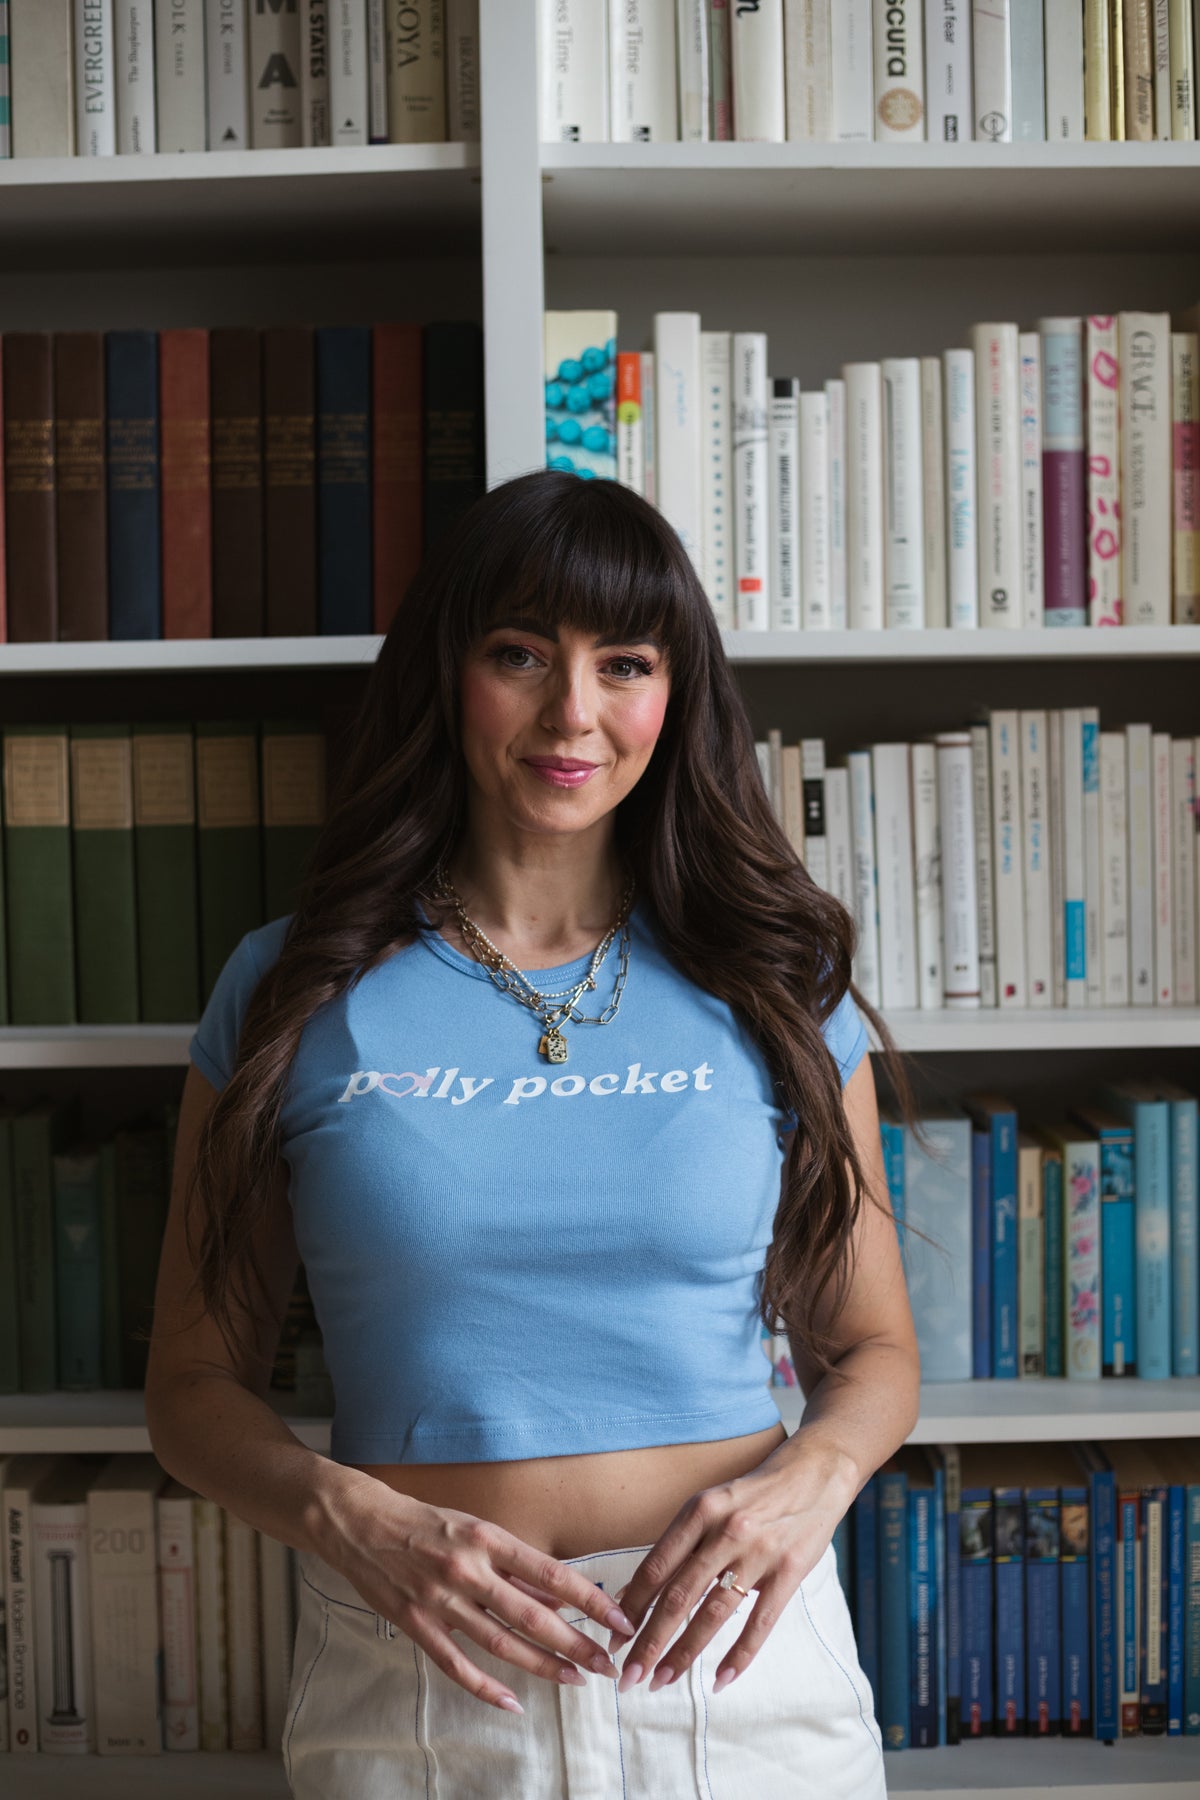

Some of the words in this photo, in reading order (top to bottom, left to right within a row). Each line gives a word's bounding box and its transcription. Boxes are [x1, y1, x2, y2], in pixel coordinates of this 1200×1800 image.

[310, 14, 325, 79] STATES
[555, 27, 574, 74] Time
[625, 27, 644, 75] Time
[943, 16, 957, 43] fear
[1156, 34, 1168, 72] YORK
[503, 1062, 714, 1105] pocket
[11, 1539, 24, 1582] Ansari
[93, 1528, 146, 1554] 200
[12, 1588, 25, 1641] Modern
[14, 1645, 27, 1709] Romance
